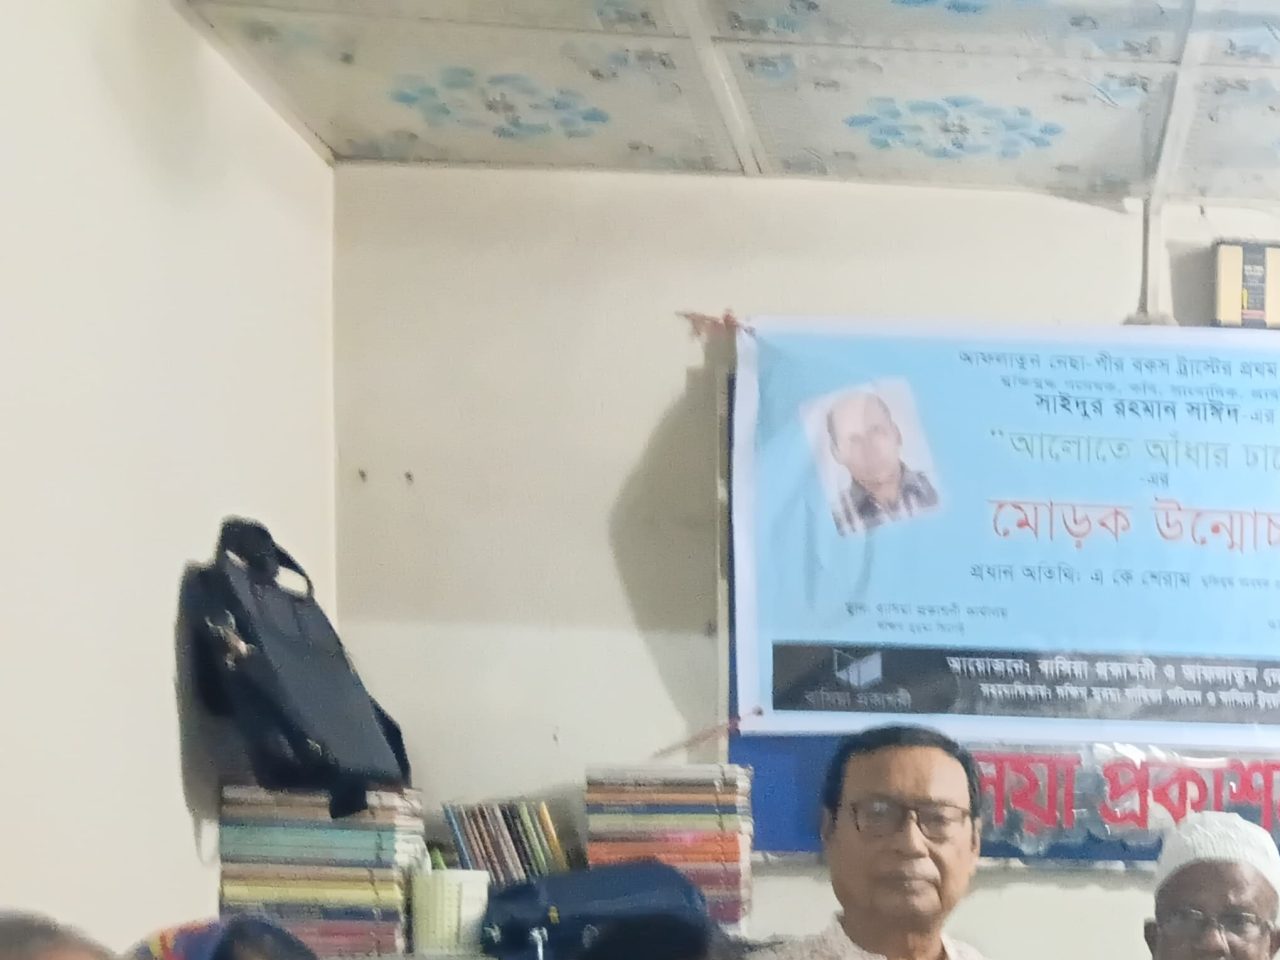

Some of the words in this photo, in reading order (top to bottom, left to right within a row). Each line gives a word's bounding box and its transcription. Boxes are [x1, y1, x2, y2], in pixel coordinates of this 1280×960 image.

[1033, 391, 1103, 420] সাইদুর
[1111, 397, 1178, 422] রহমান
[1143, 431, 1231, 471] আঁধার
[986, 496, 1134, 551] মোড়ক
[969, 562, 1015, 583] প্রধান
[1090, 569, 1104, 586] এ
[1111, 569, 1134, 588] কে
